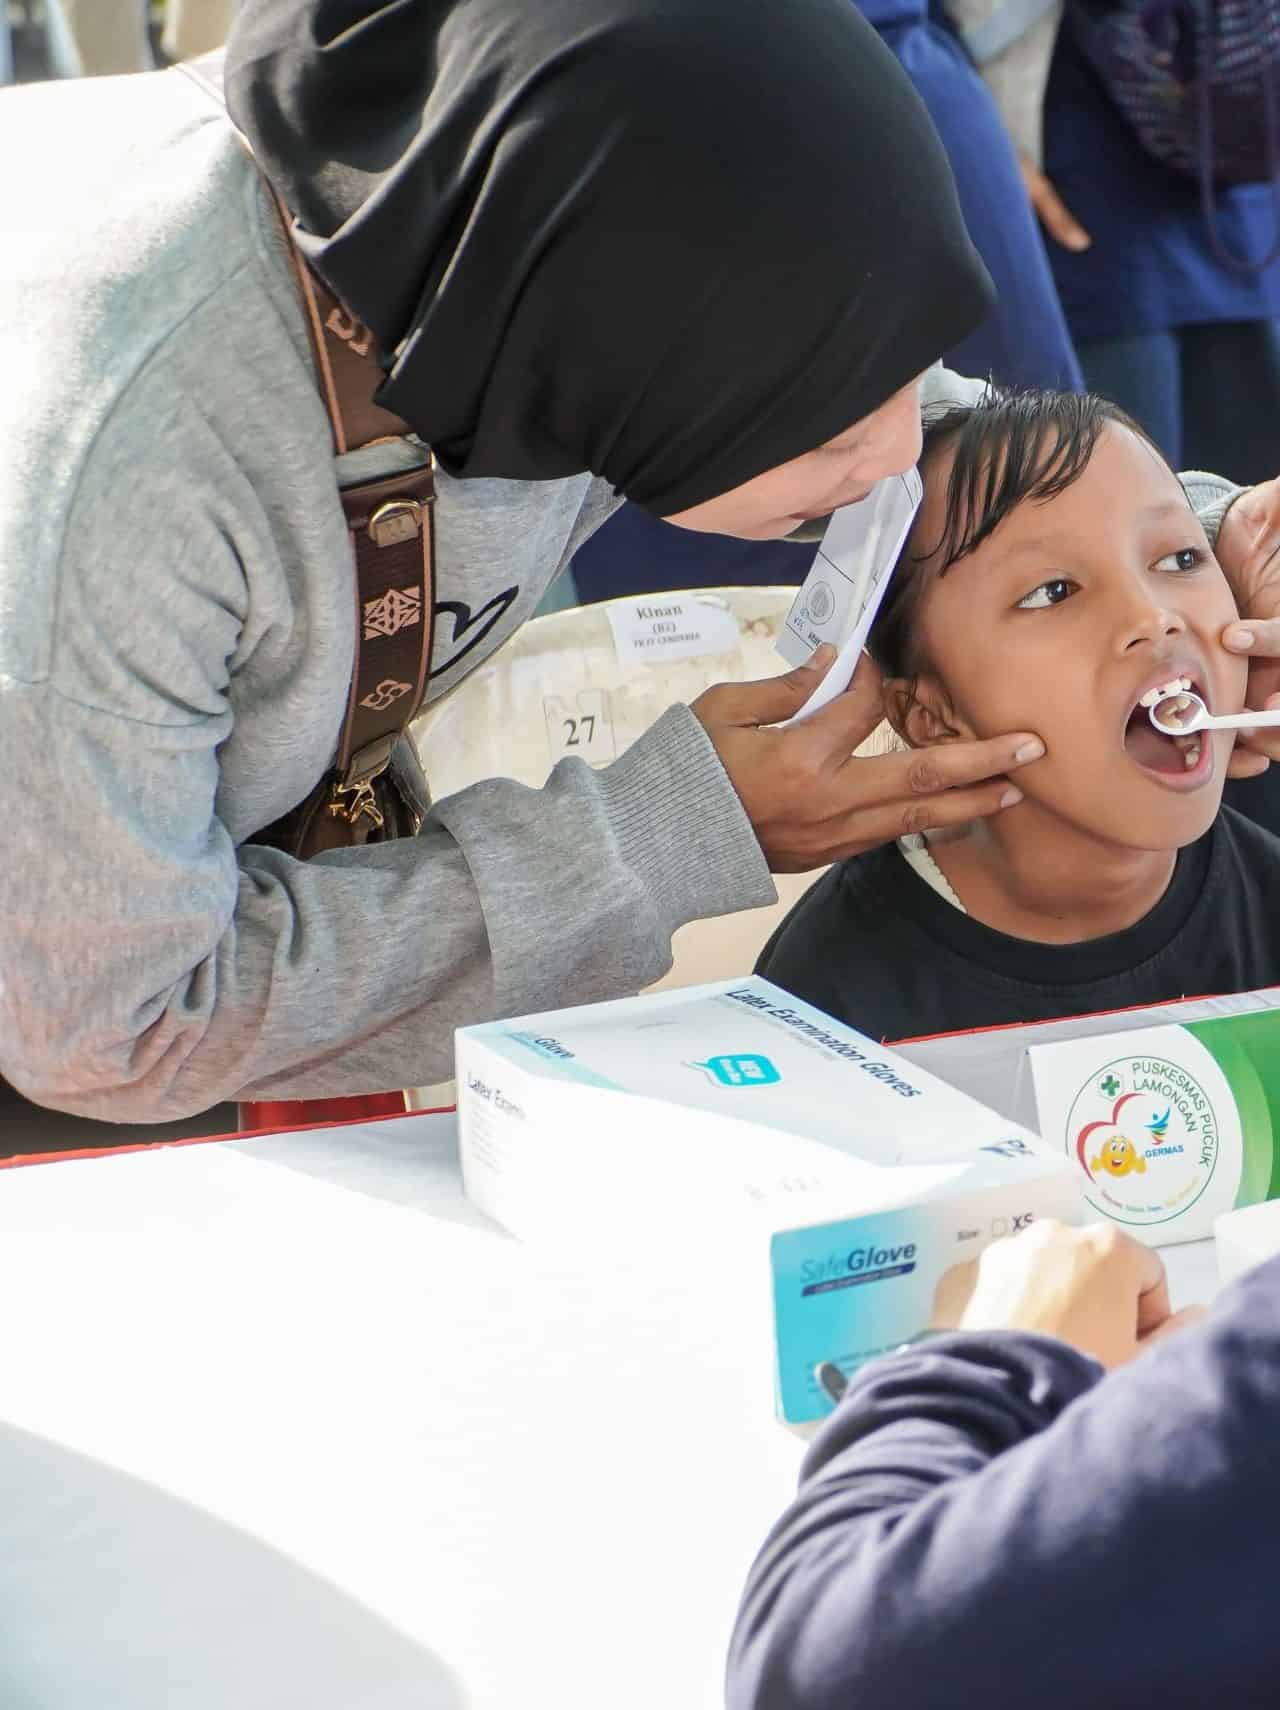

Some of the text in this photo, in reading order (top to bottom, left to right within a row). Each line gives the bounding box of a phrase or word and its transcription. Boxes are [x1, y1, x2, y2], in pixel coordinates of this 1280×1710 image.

[563, 715, 596, 746] 27
[727, 988, 922, 1098] Latex Examination Gloves
[1131, 1061, 1215, 1168] PUSKESMAS PUCUK
[1132, 1079, 1198, 1133] LAMONGAN
[1145, 1145, 1184, 1158] GERMAS
